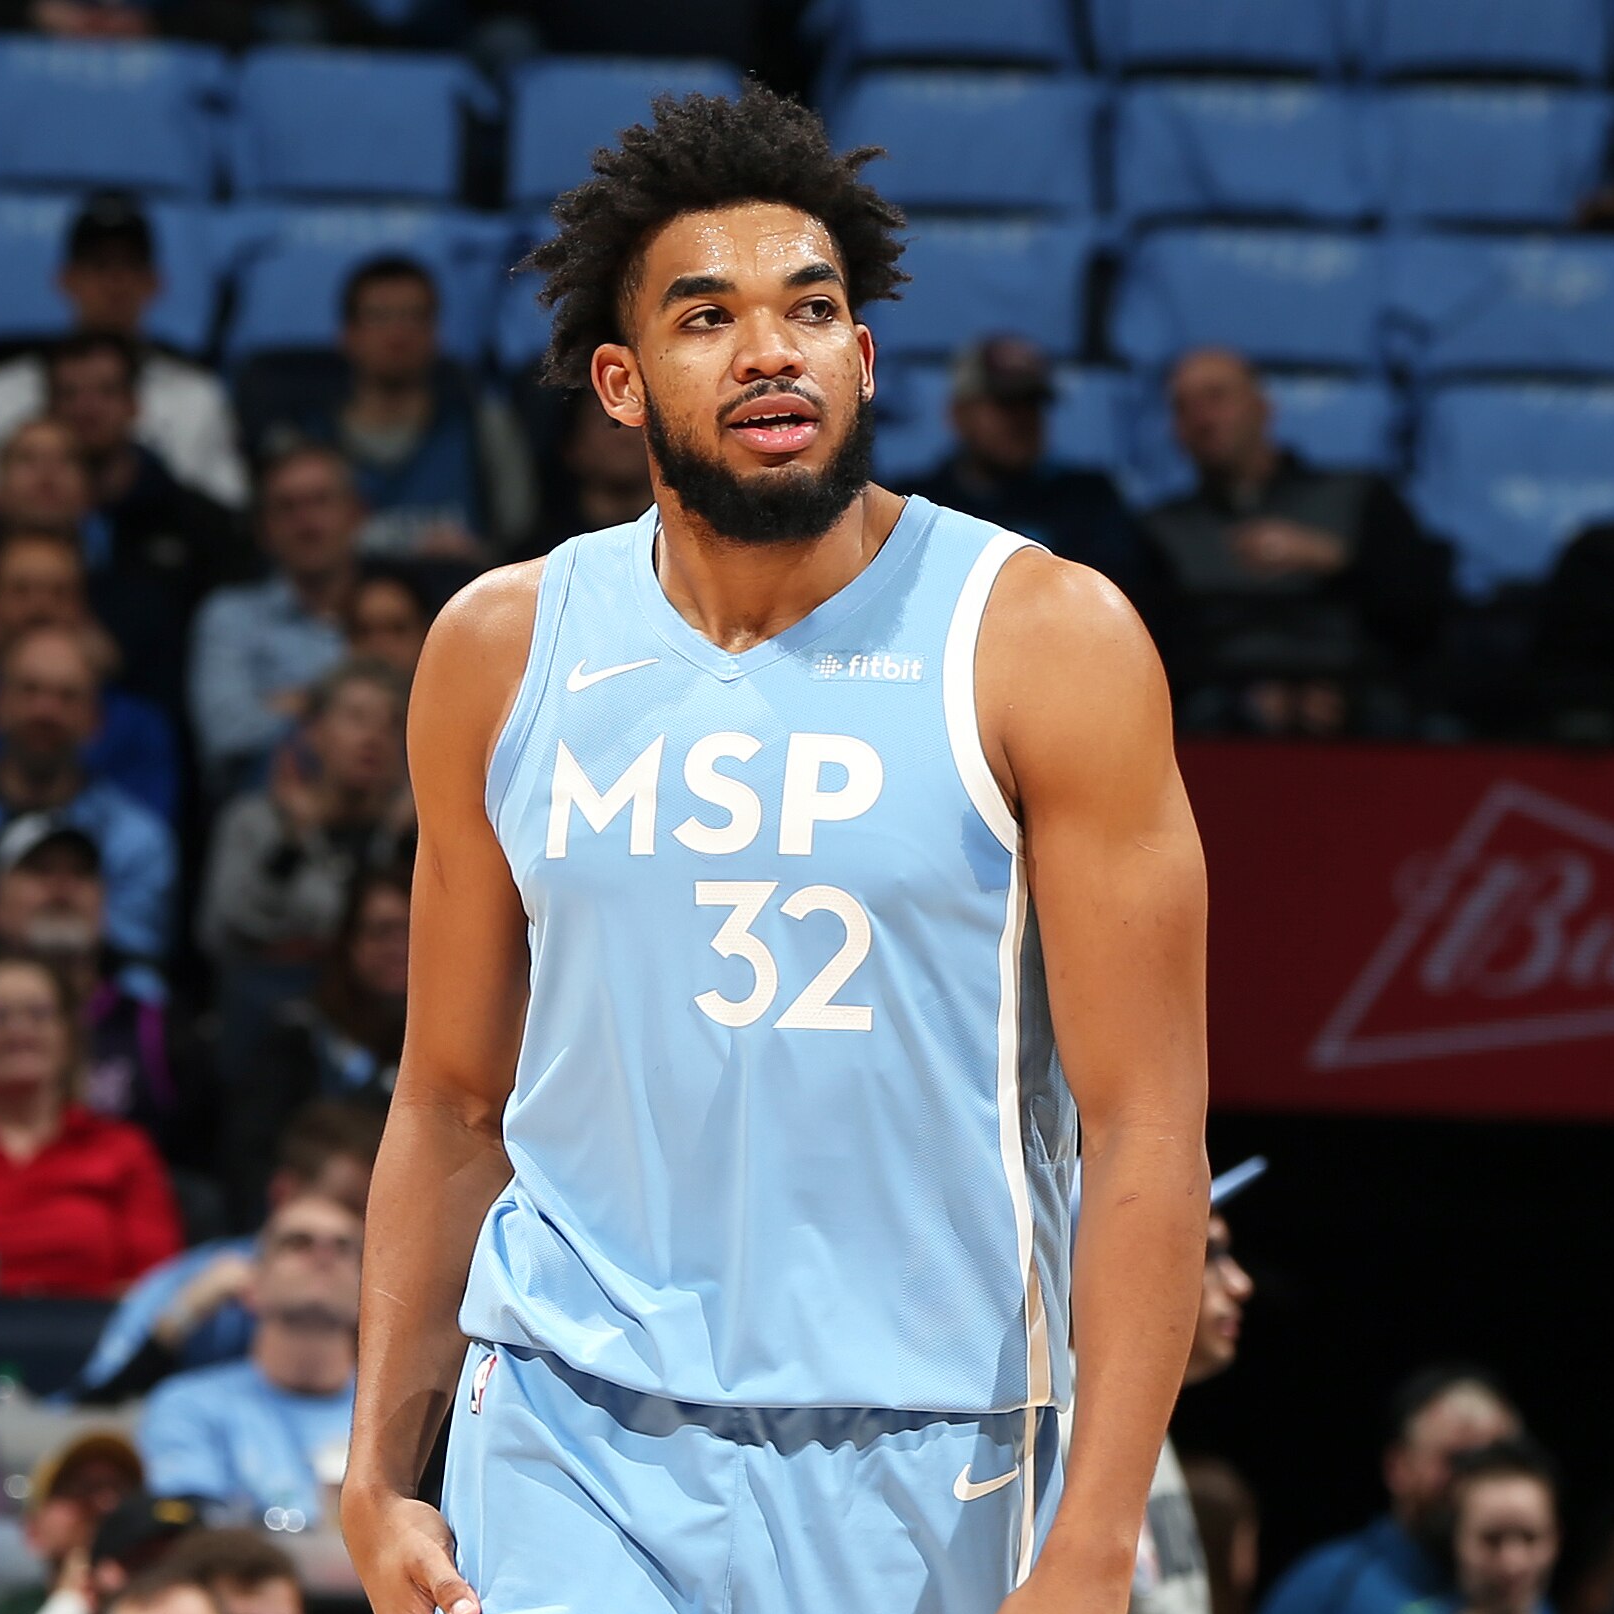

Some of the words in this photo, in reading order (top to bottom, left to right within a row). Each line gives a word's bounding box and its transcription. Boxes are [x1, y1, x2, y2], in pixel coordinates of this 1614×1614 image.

[848, 654, 923, 680] fitbit
[545, 731, 884, 859] MSP
[694, 880, 874, 1031] 32
